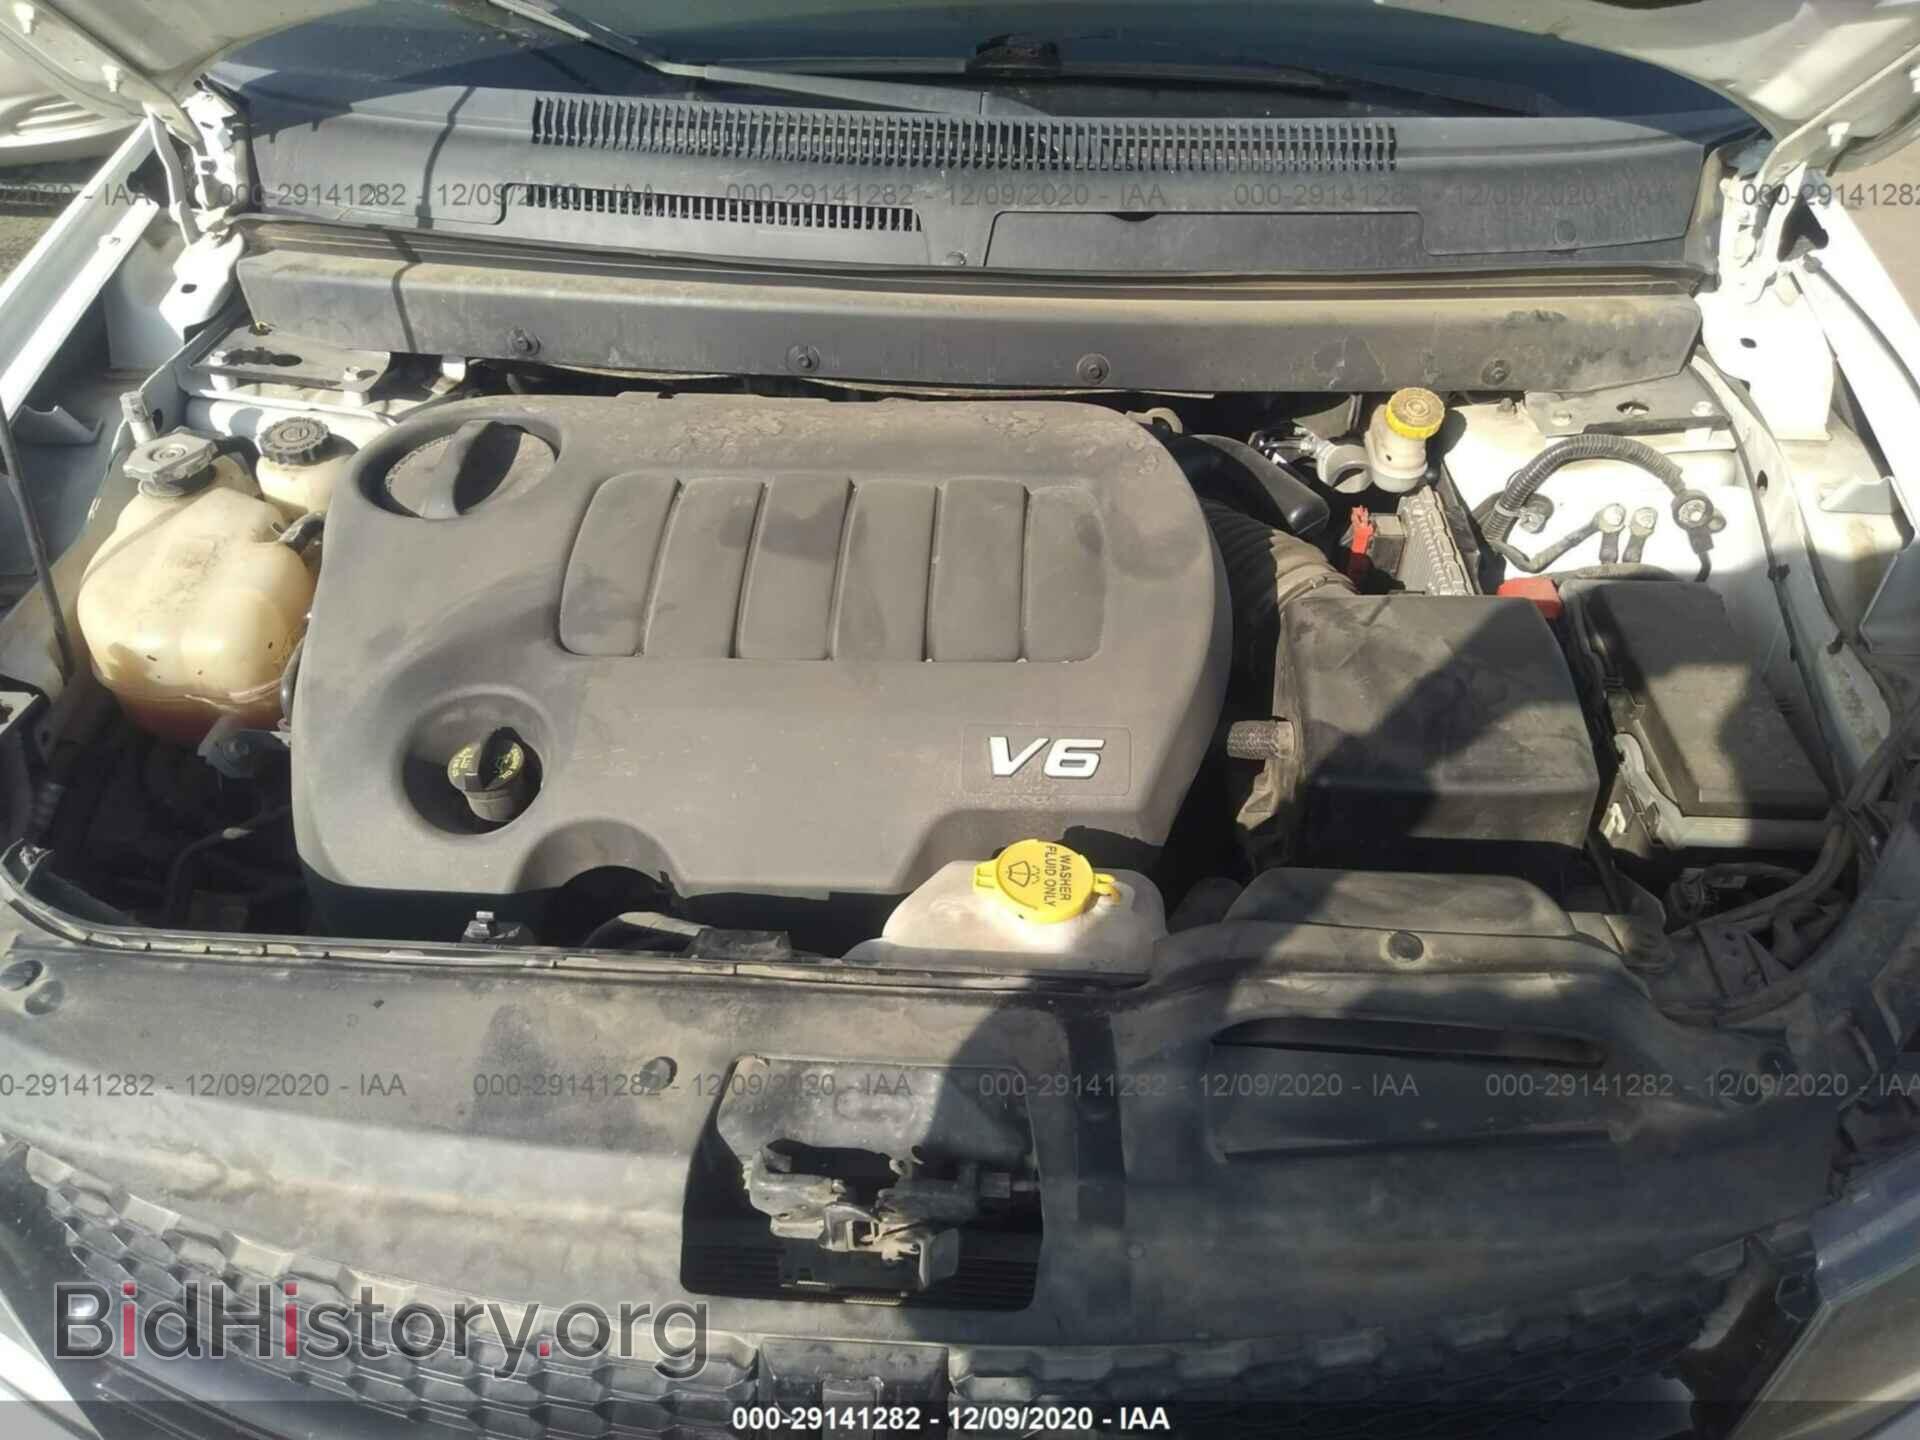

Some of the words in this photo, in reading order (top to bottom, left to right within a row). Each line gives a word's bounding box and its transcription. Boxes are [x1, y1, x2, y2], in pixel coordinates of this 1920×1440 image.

[989, 736, 1106, 779] V6
[1044, 845, 1057, 876] FLUID
[1060, 854, 1072, 901] WASHER
[1044, 879, 1057, 907] ONLY
